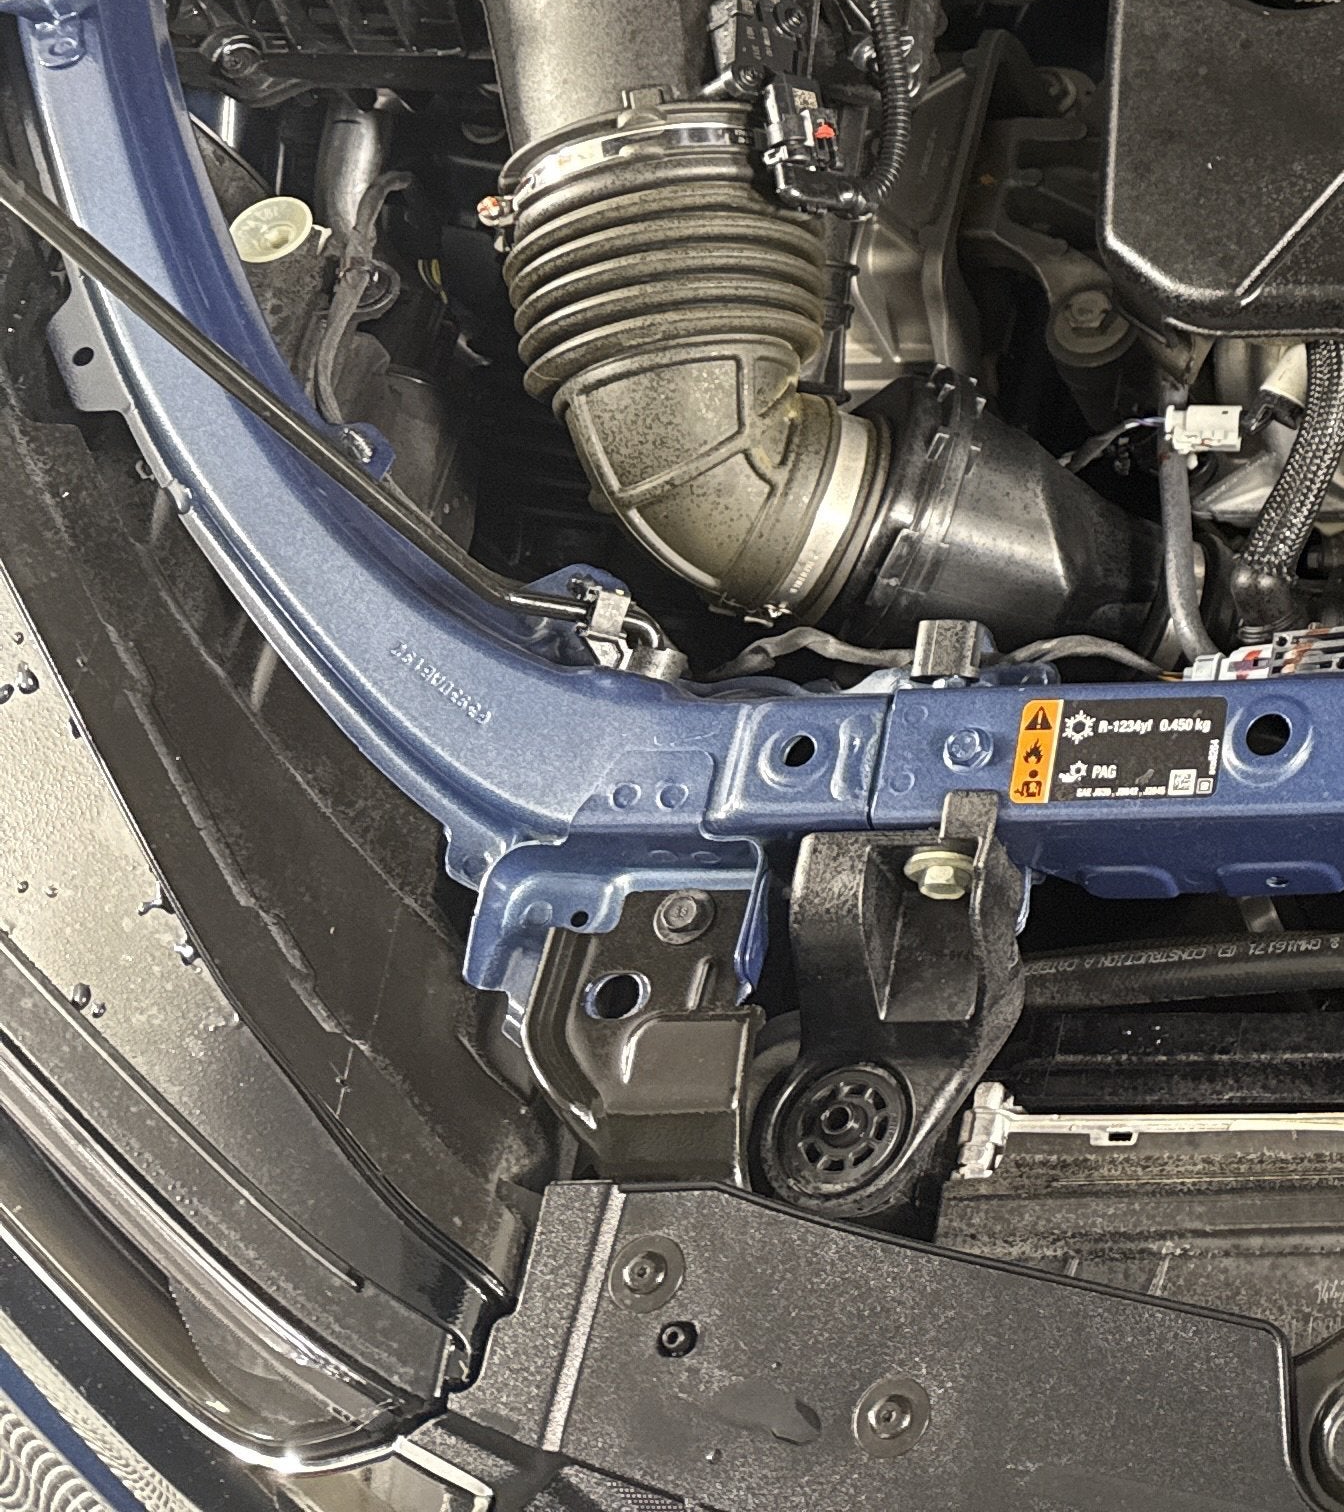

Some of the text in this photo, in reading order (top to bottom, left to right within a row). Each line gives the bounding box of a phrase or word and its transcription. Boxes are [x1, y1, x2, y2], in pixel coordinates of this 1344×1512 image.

[1098, 718, 1211, 735] R-1234yf 0.450 kg
[1091, 765, 1117, 779] PAG
[1095, 945, 1206, 968] CONSTRUCTION
